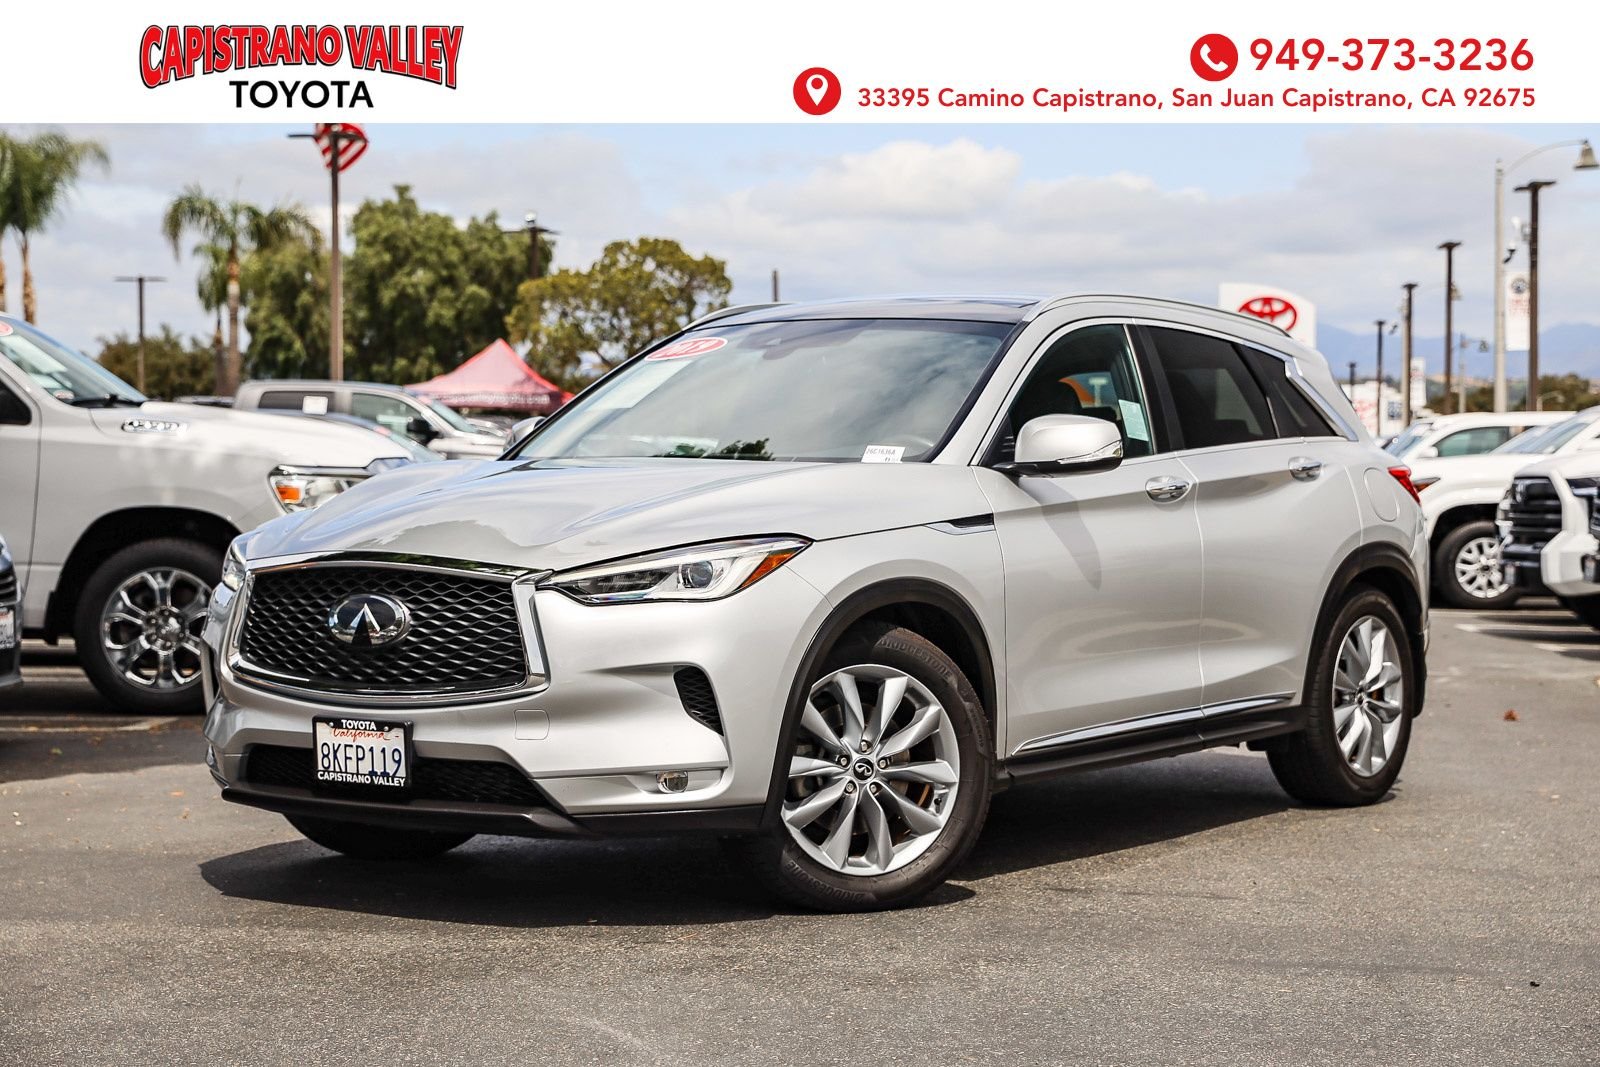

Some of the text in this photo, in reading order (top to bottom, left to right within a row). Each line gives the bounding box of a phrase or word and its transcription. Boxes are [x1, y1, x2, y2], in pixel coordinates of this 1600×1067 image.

[341, 719, 377, 731] TOYOTA
[321, 742, 402, 777] 8KFP119
[317, 771, 405, 787] CAPISTRANO VALLEY
